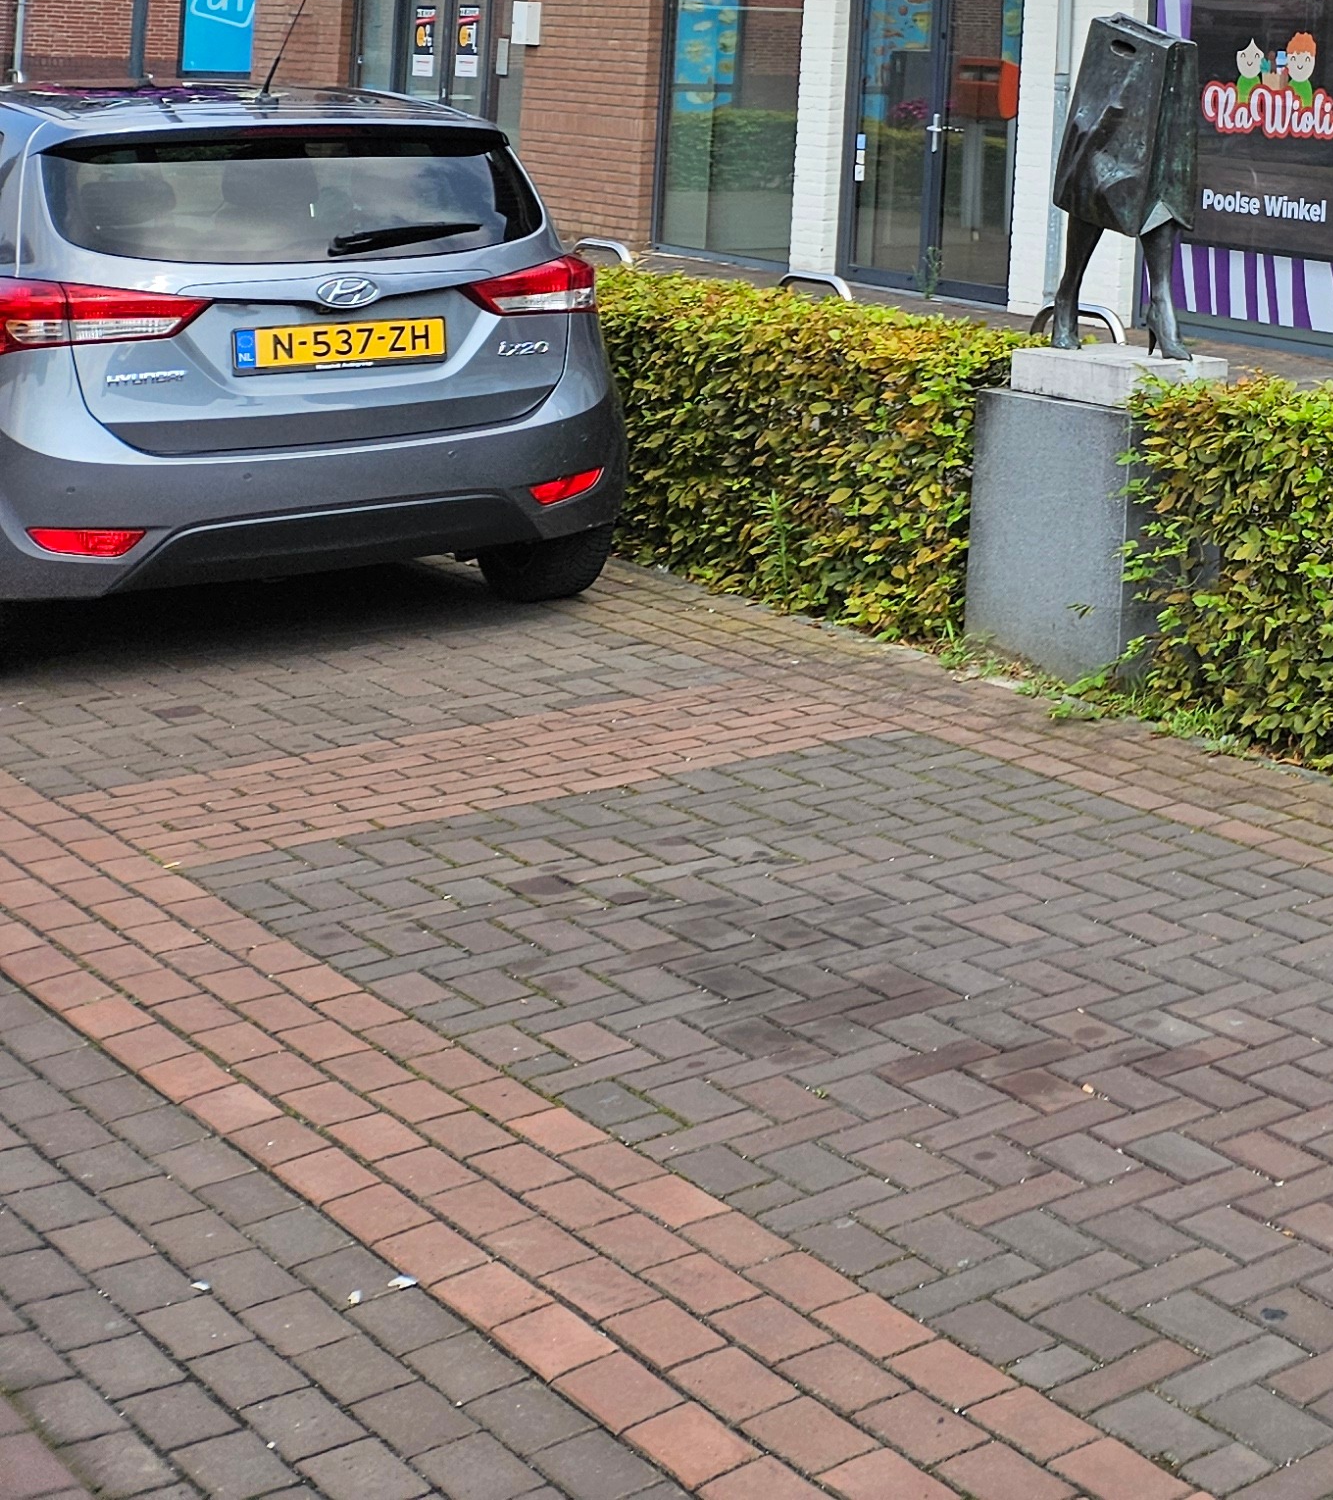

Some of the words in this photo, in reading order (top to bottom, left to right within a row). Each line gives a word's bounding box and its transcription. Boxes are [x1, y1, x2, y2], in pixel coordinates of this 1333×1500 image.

[1202, 188, 1260, 215] Poolse
[1263, 194, 1327, 223] Winkel
[238, 353, 254, 362] NL
[272, 324, 430, 360] N-537-ZH
